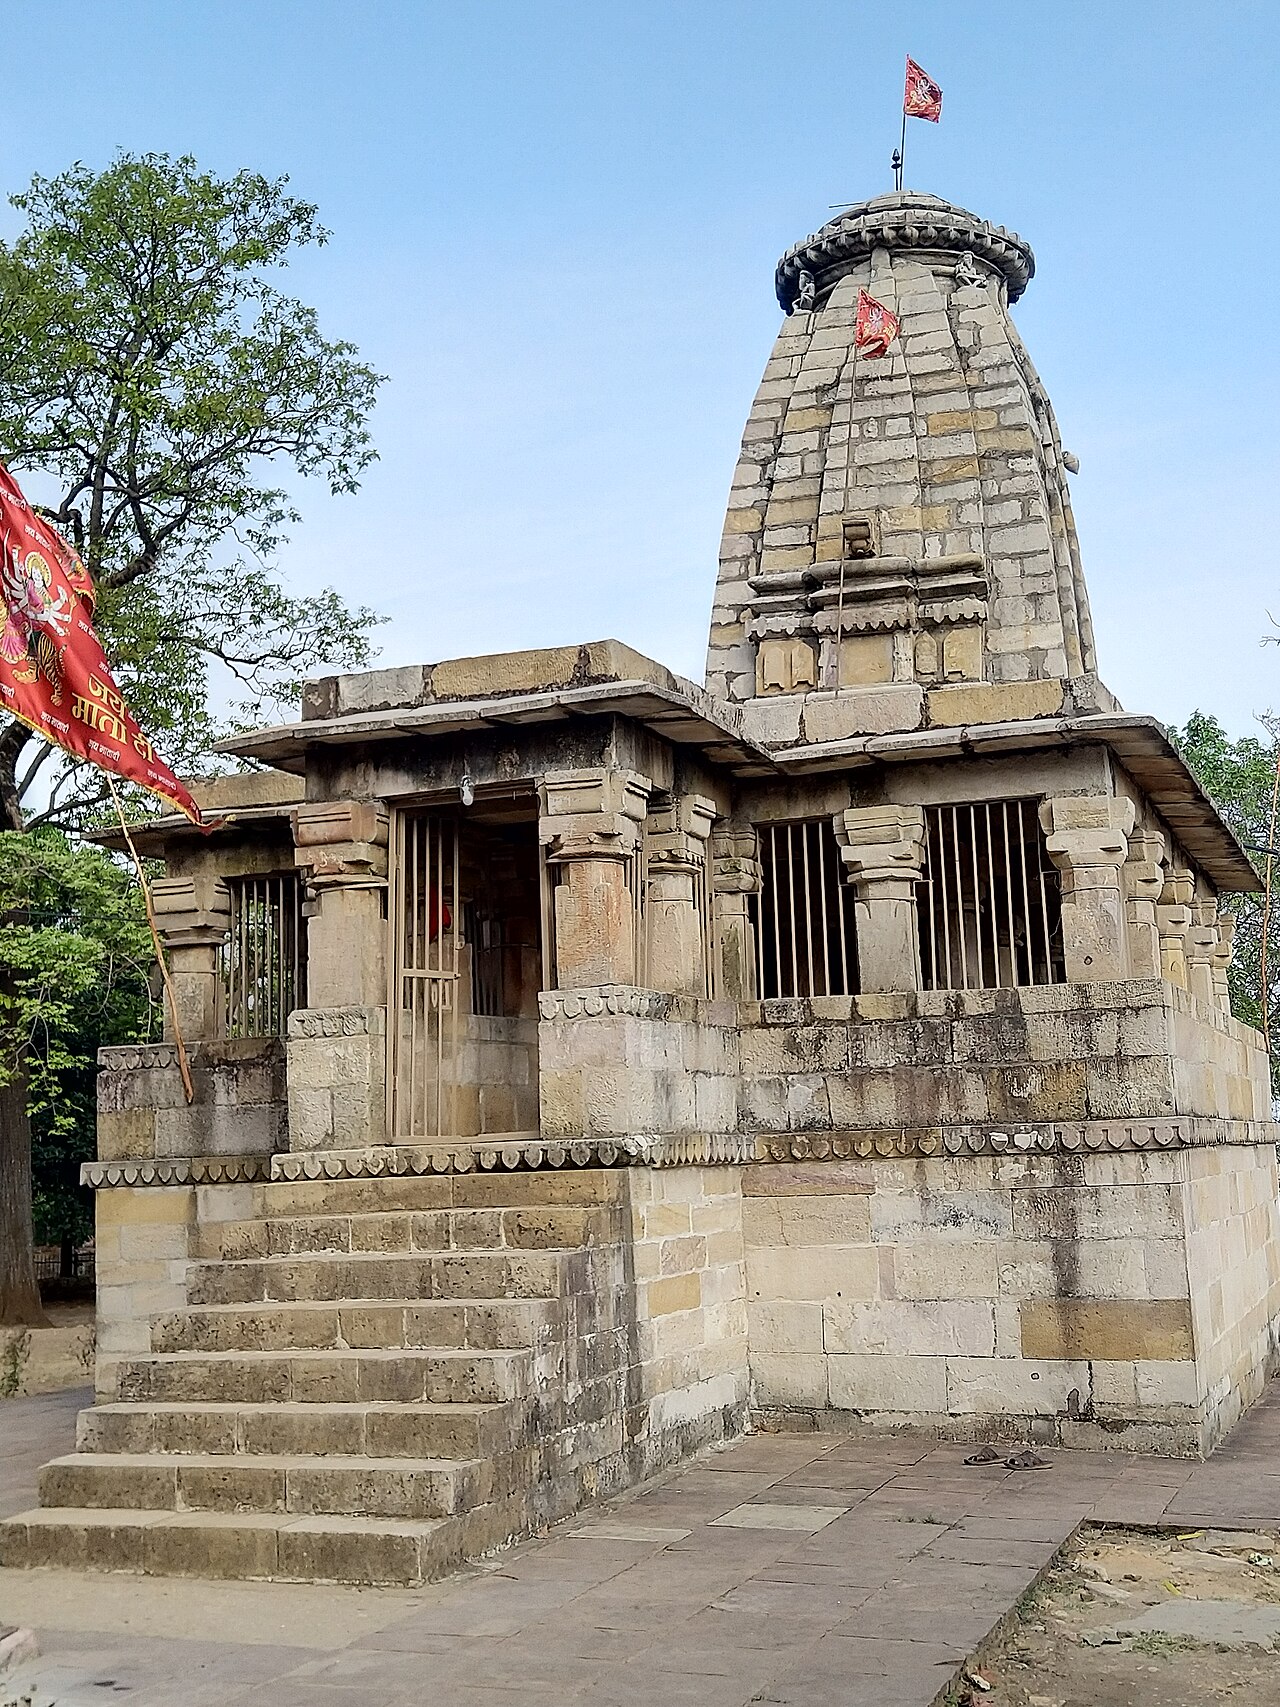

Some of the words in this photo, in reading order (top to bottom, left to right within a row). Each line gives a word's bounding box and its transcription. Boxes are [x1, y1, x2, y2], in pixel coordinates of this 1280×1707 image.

[88, 672, 126, 722] जय
[71, 692, 127, 745] माता
[131, 732, 155, 764] दी
